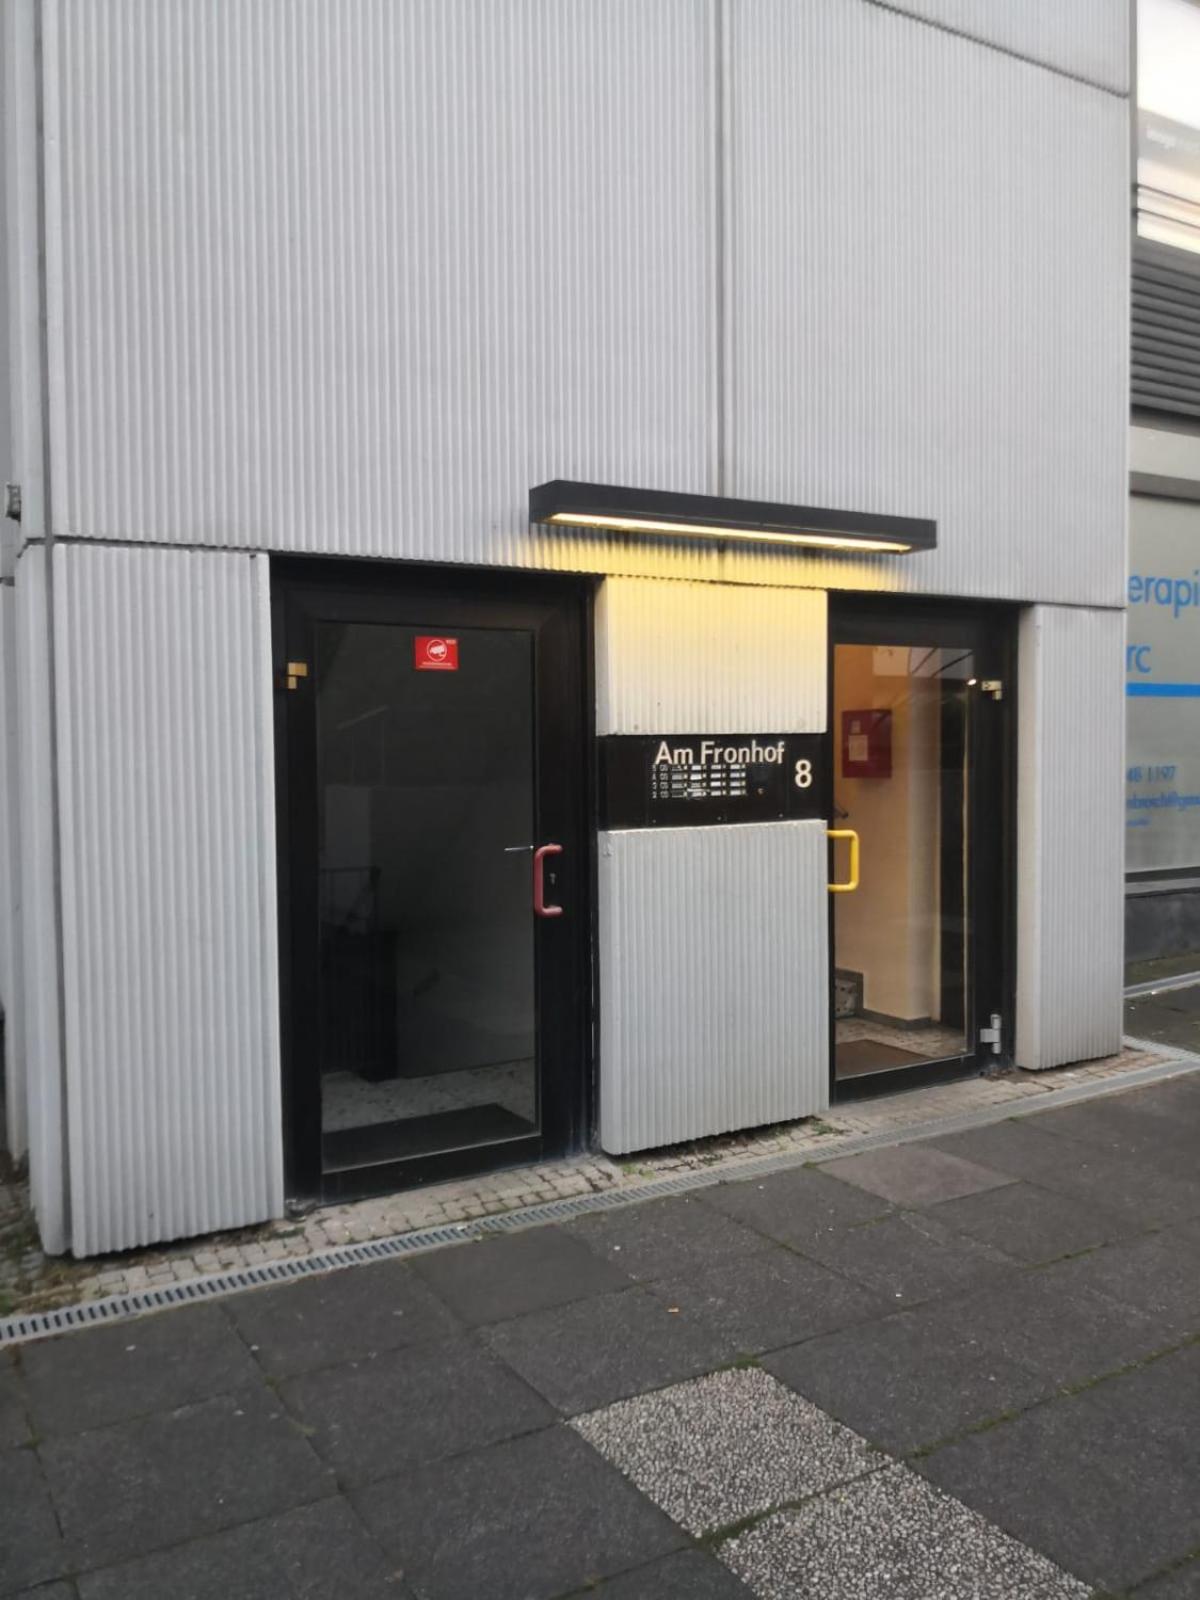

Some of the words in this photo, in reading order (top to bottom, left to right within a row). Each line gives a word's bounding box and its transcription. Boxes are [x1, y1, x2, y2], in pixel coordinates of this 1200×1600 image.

[655, 740, 694, 765] Am
[701, 739, 785, 764] Fronhof
[795, 759, 813, 788] 8
